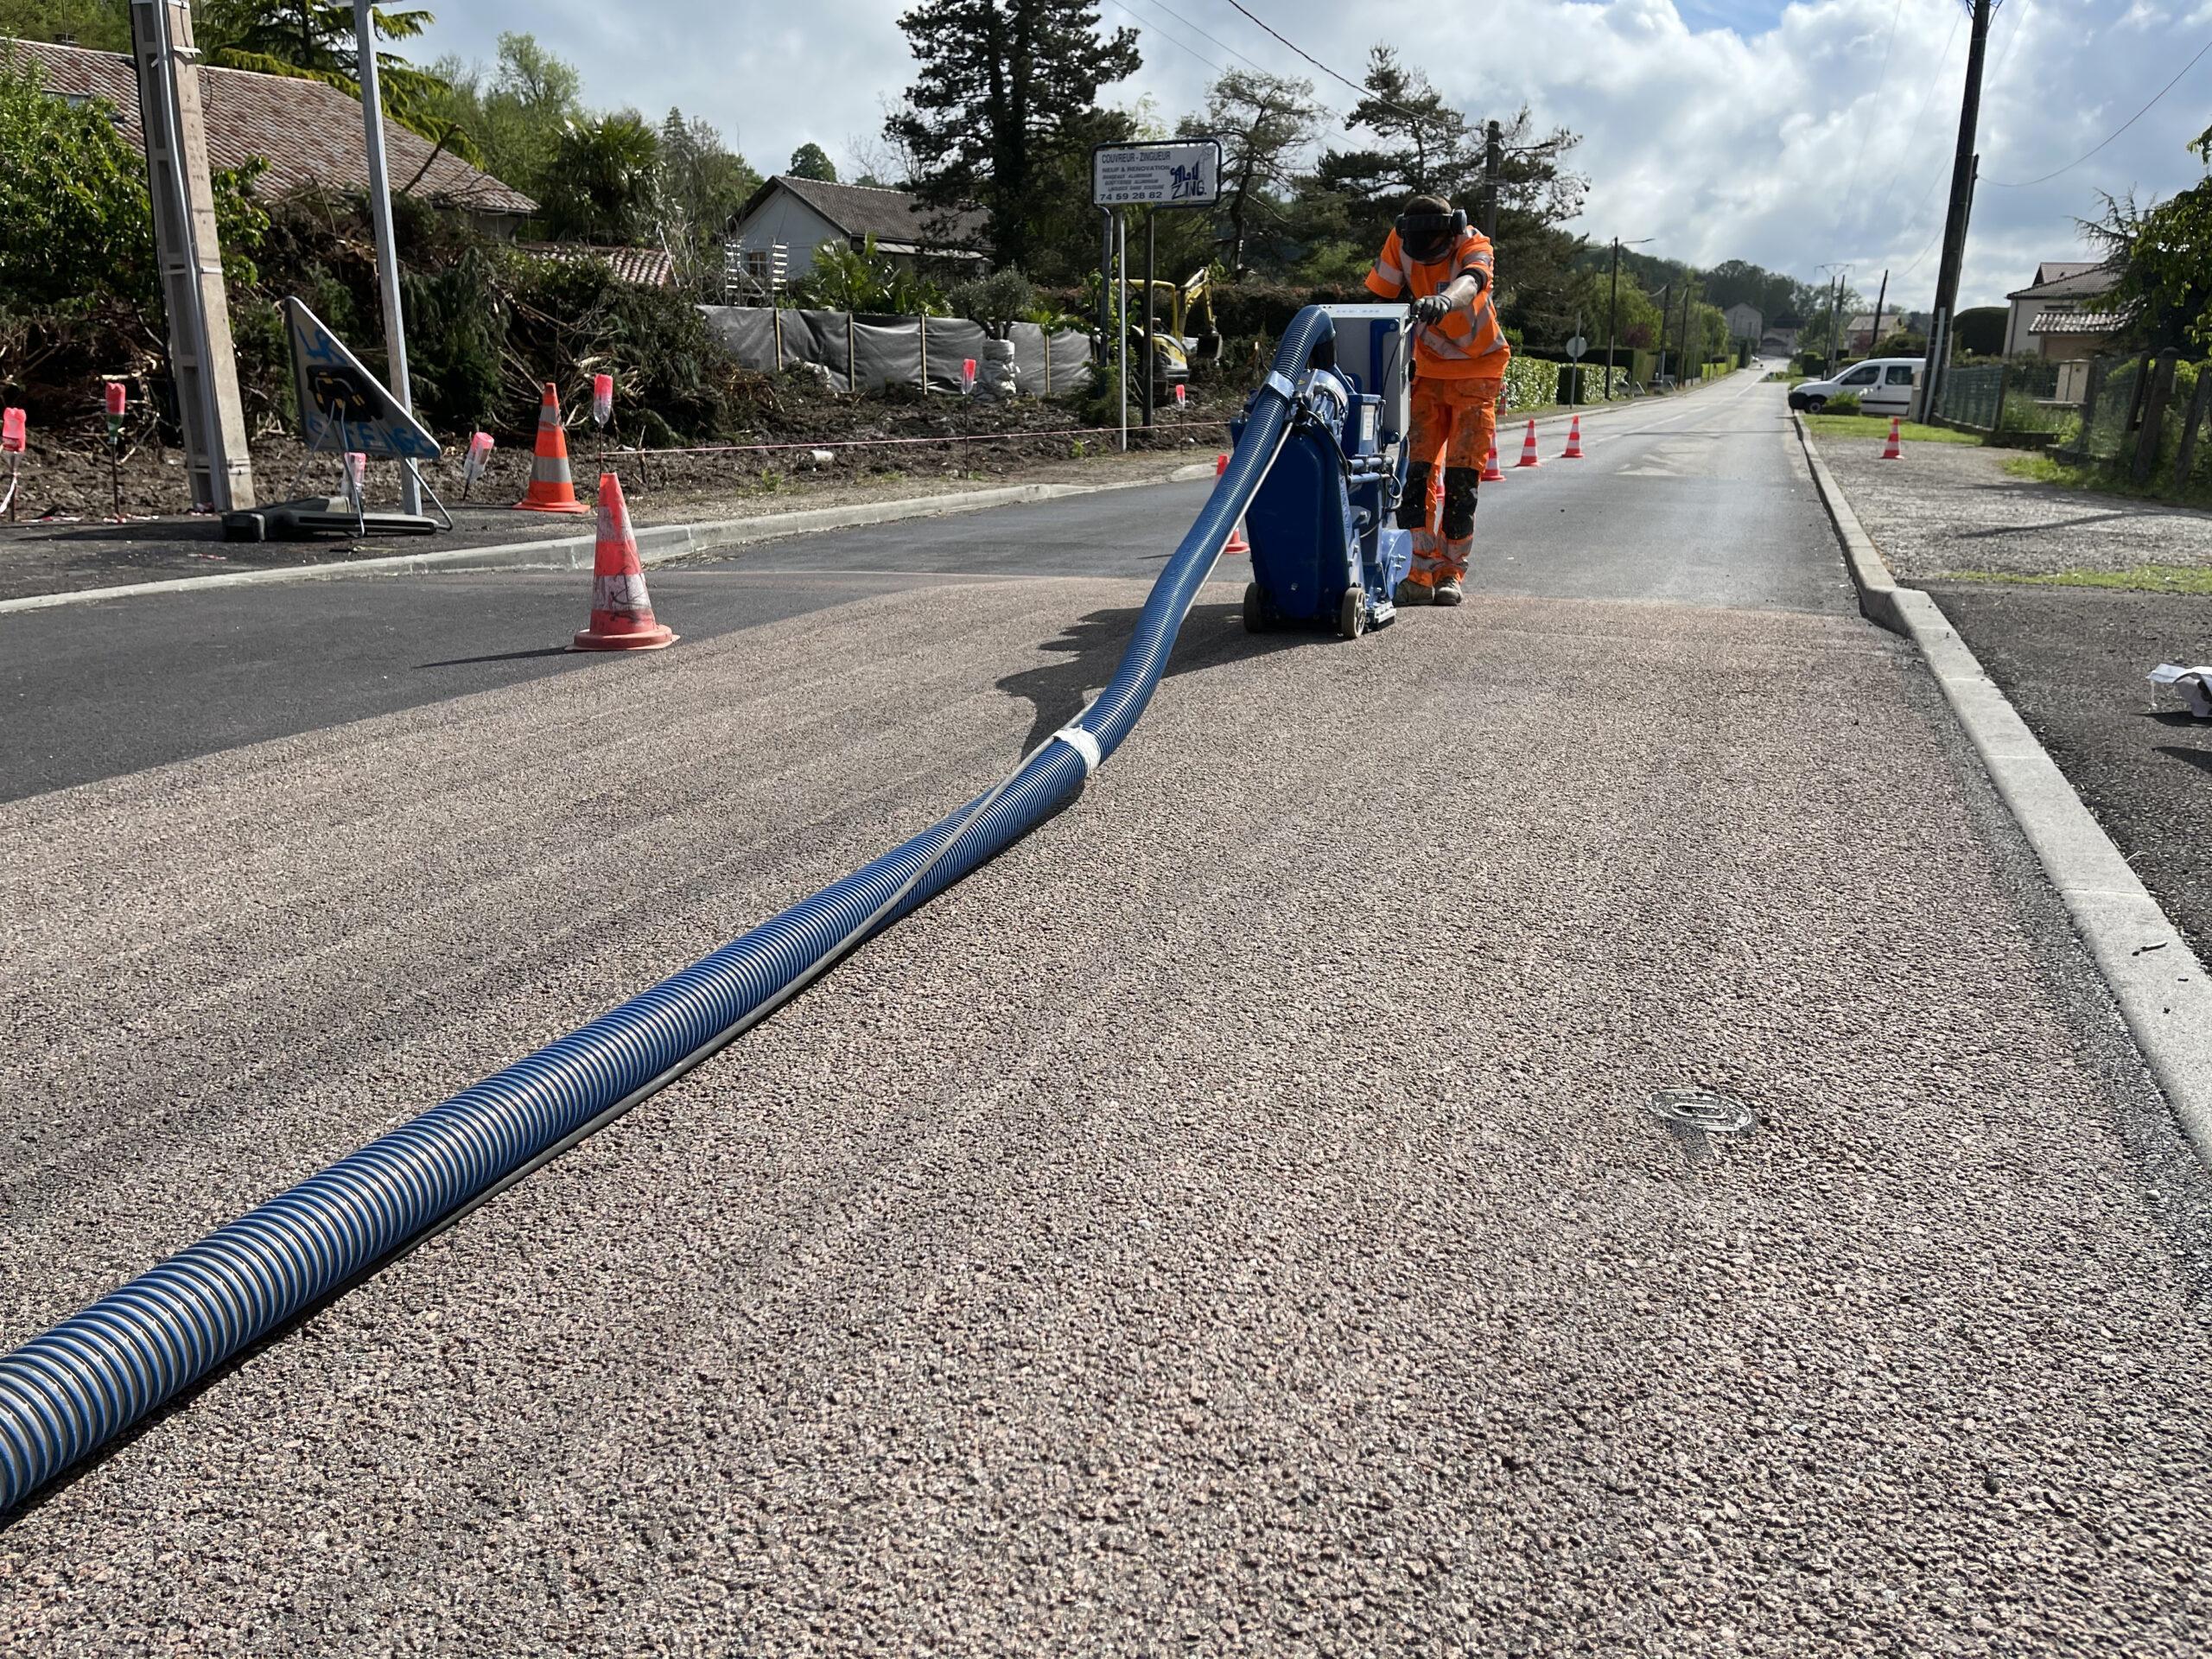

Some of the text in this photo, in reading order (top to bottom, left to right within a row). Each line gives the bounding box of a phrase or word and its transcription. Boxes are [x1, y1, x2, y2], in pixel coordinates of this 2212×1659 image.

[1102, 152, 1135, 163] COUVREUR
[1140, 150, 1171, 162] ZINGUEUR
[1132, 191, 1146, 200] 28
[1149, 190, 1162, 199] 82
